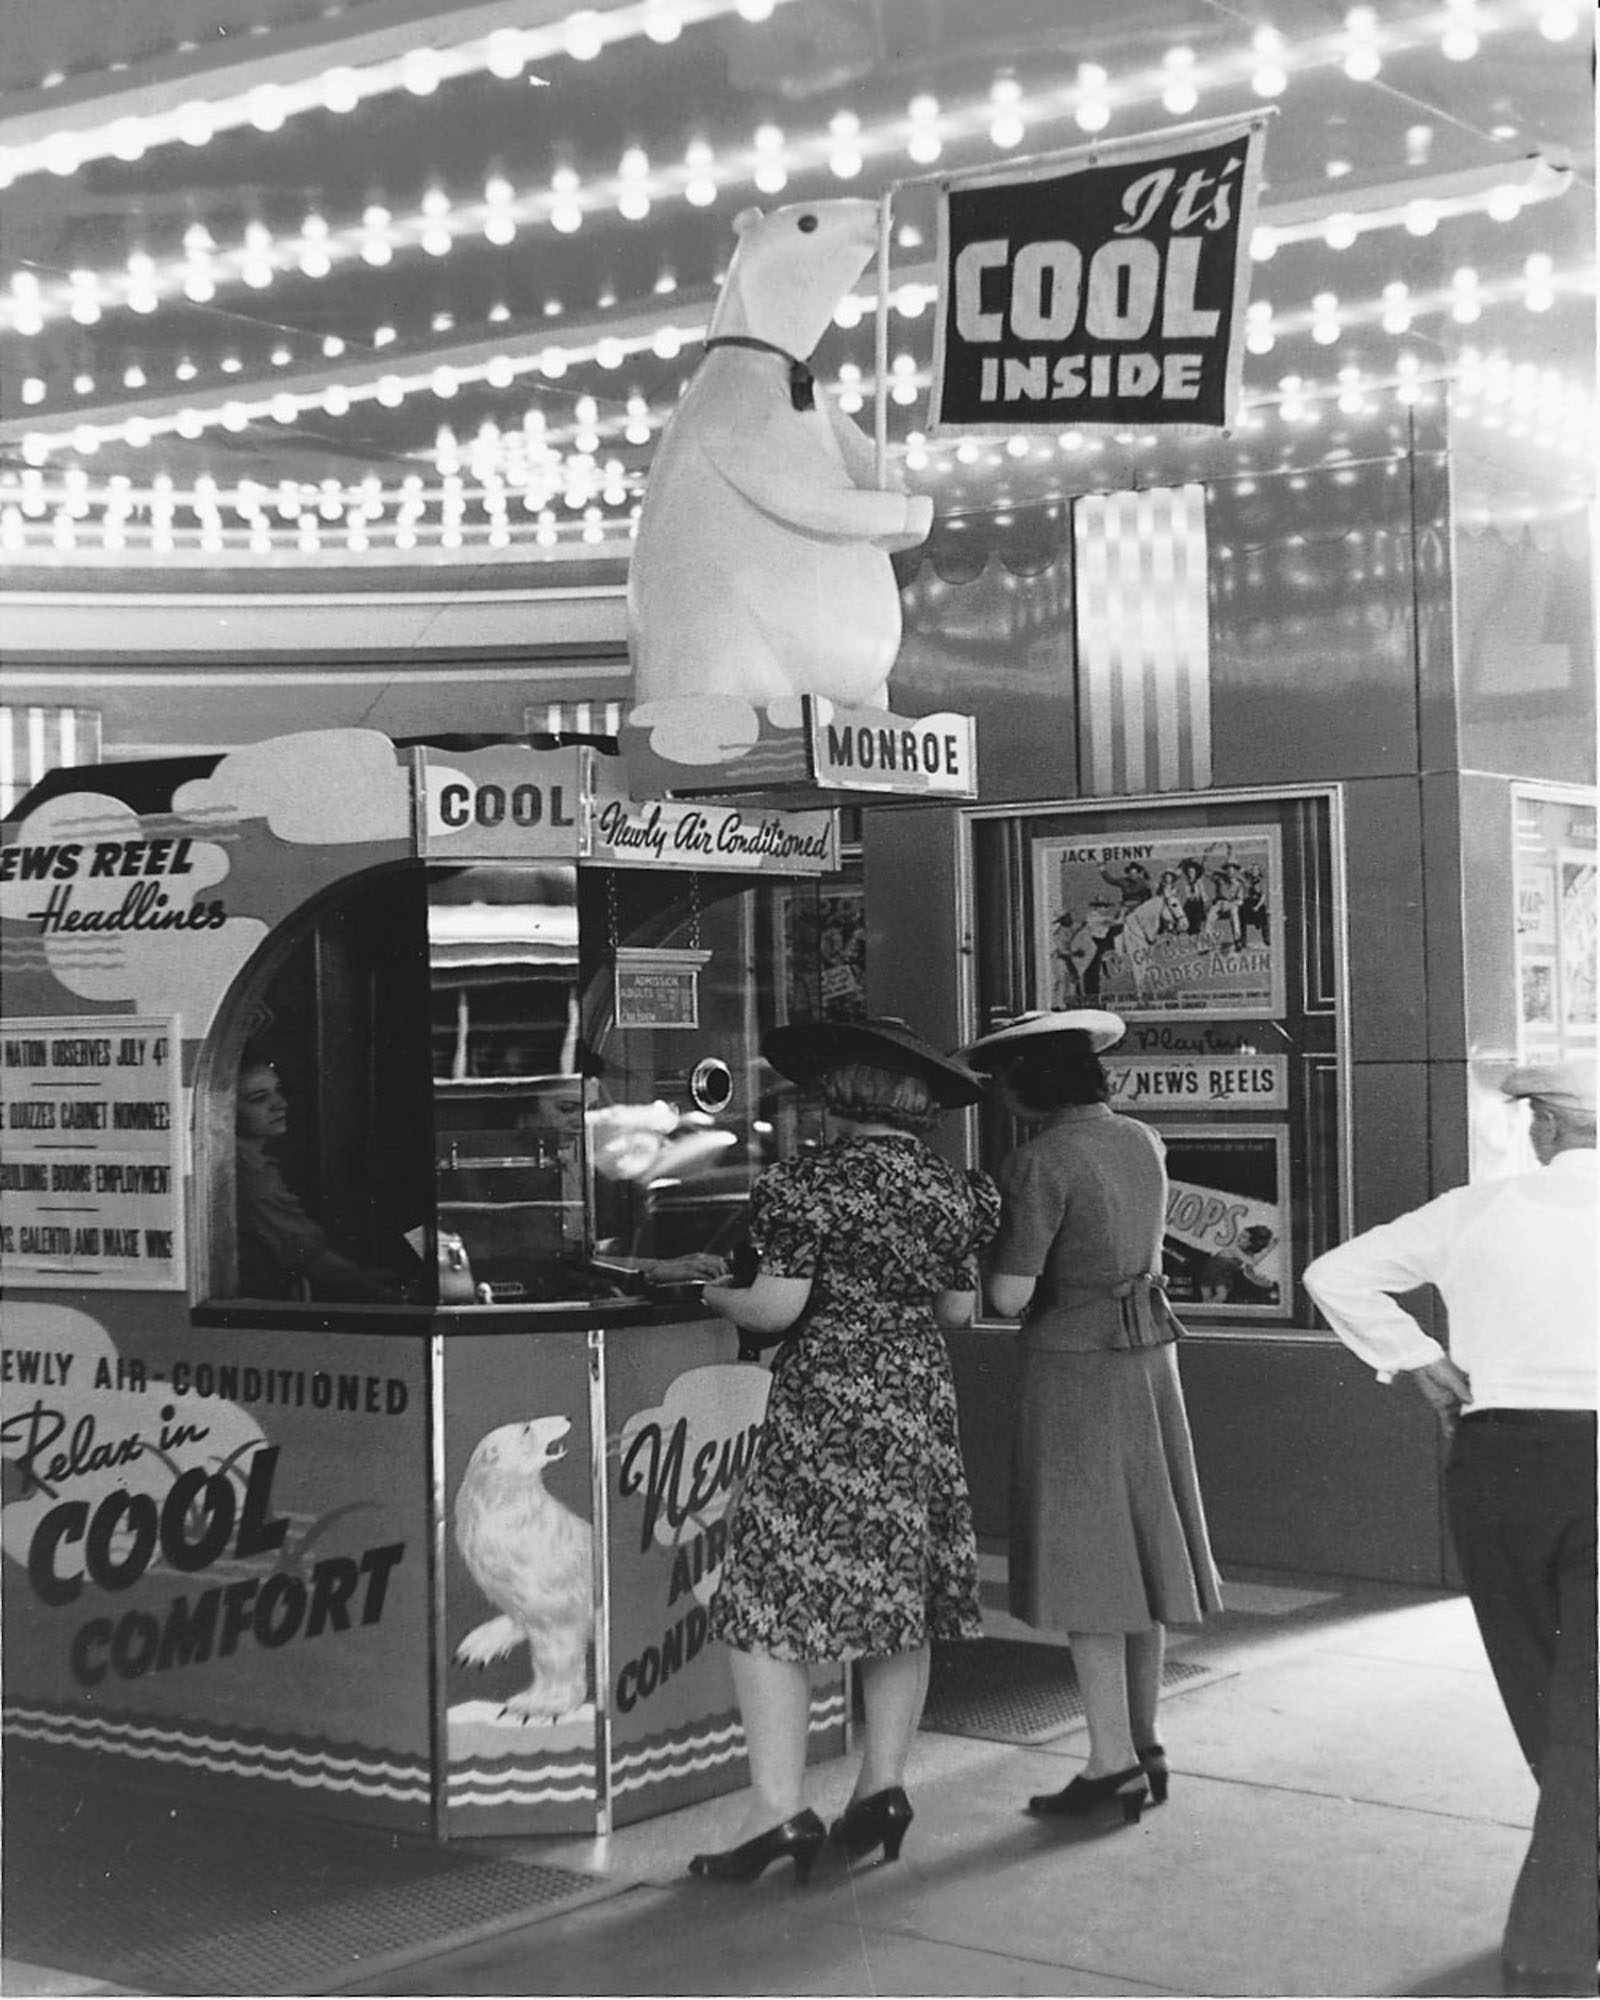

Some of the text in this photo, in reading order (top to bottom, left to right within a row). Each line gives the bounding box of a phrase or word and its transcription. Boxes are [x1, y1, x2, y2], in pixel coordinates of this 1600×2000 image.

[1113, 157, 1242, 234] It's
[955, 236, 1221, 342] COOL
[979, 353, 1203, 401] INSIDE
[828, 726, 959, 776] MONROE
[440, 784, 575, 828] COOL
[600, 801, 830, 859] Newly Air Conditioned
[89, 838, 193, 877] REEL
[1060, 845, 1153, 863] JACK BENNY
[27, 881, 226, 934] Headlines
[1211, 952, 1271, 977] AGAIN
[52, 1038, 111, 1066] OBSERVES
[116, 1037, 146, 1066] JULY
[1136, 1071, 1199, 1094] NEWS
[1209, 1069, 1274, 1094] REELS
[75, 1227, 98, 1255] AND
[94, 1356, 409, 1415] AIR-CONDITIONED
[0, 1400, 210, 1499] Relax in
[28, 1446, 290, 1607] COOL
[70, 1543, 406, 1687] COMFORT
[616, 1605, 708, 1713] COND
